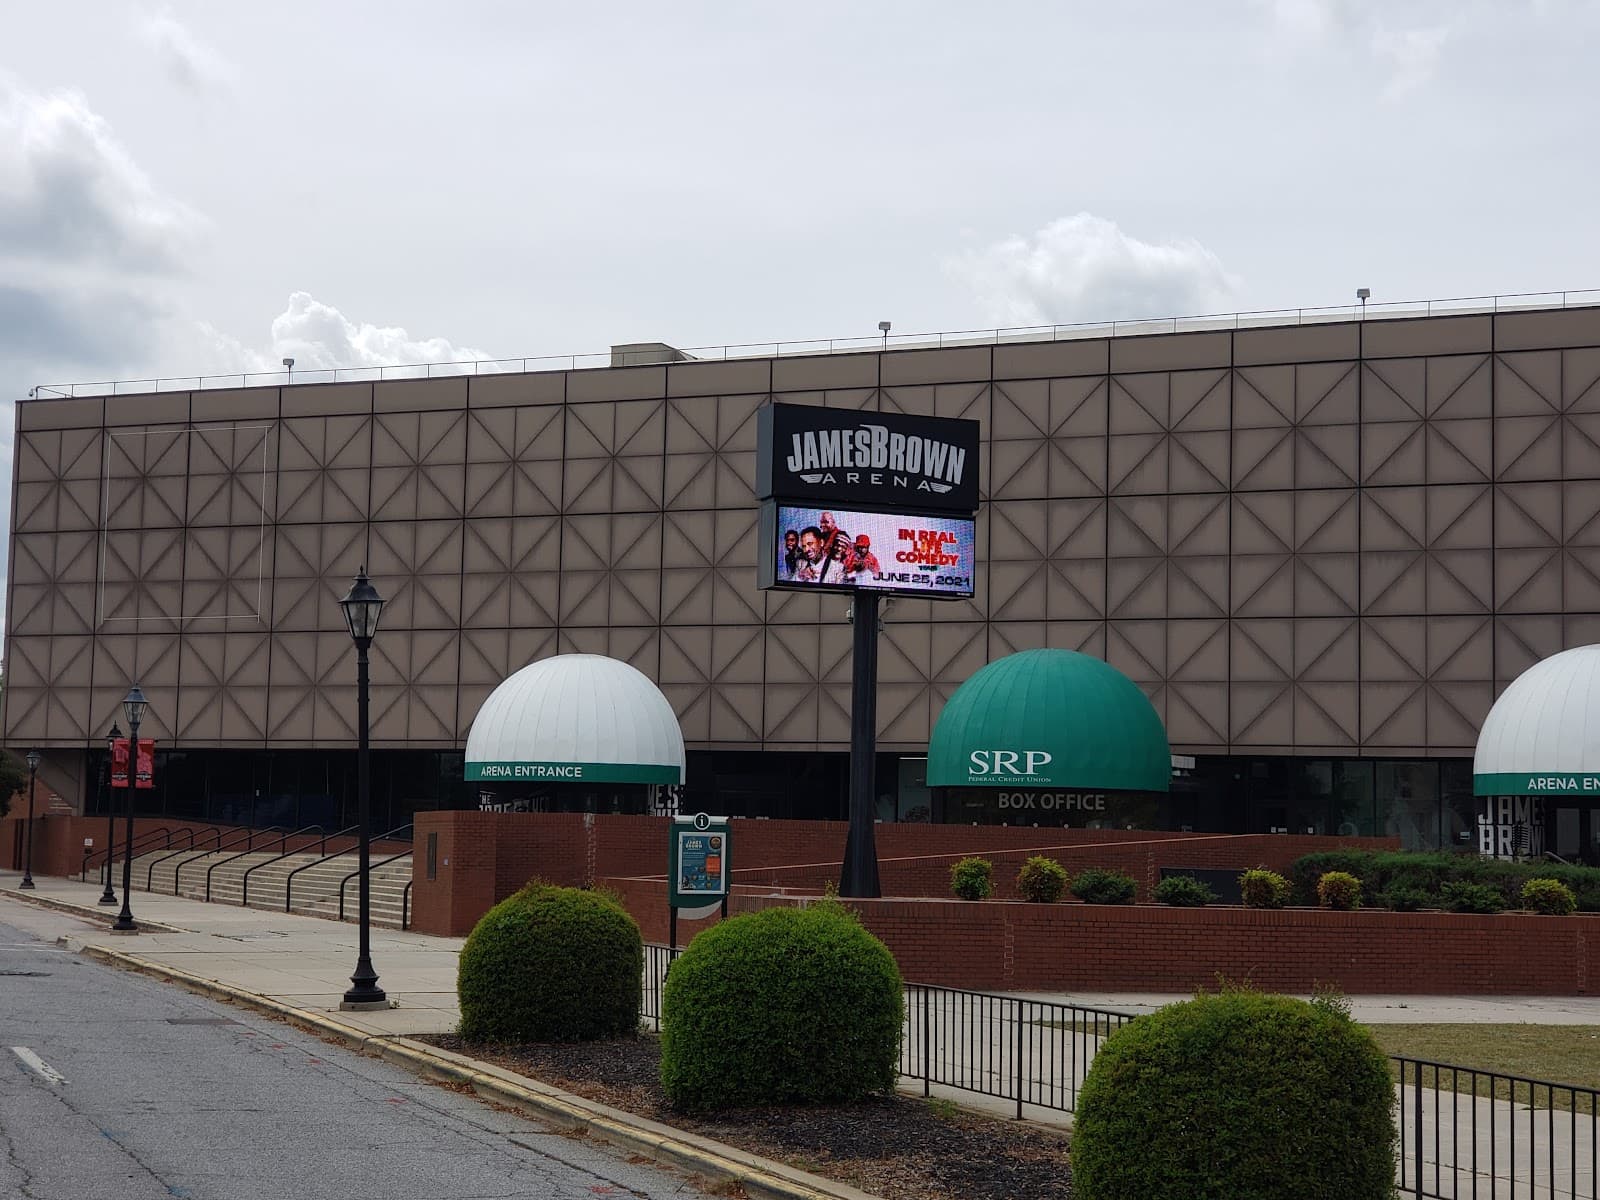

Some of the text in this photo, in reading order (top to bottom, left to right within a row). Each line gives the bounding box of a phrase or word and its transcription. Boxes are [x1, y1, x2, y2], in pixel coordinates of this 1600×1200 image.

[822, 472, 931, 492] ARENA
[898, 529, 957, 544] IN REAL
[896, 550, 959, 566] COMEDY
[873, 571, 910, 583] JUNE
[968, 750, 1053, 775] SRP
[480, 765, 583, 778] ARENA ENTRANCE
[1527, 777, 1579, 790] ARENA
[998, 792, 1105, 811] BOX OFFICE
